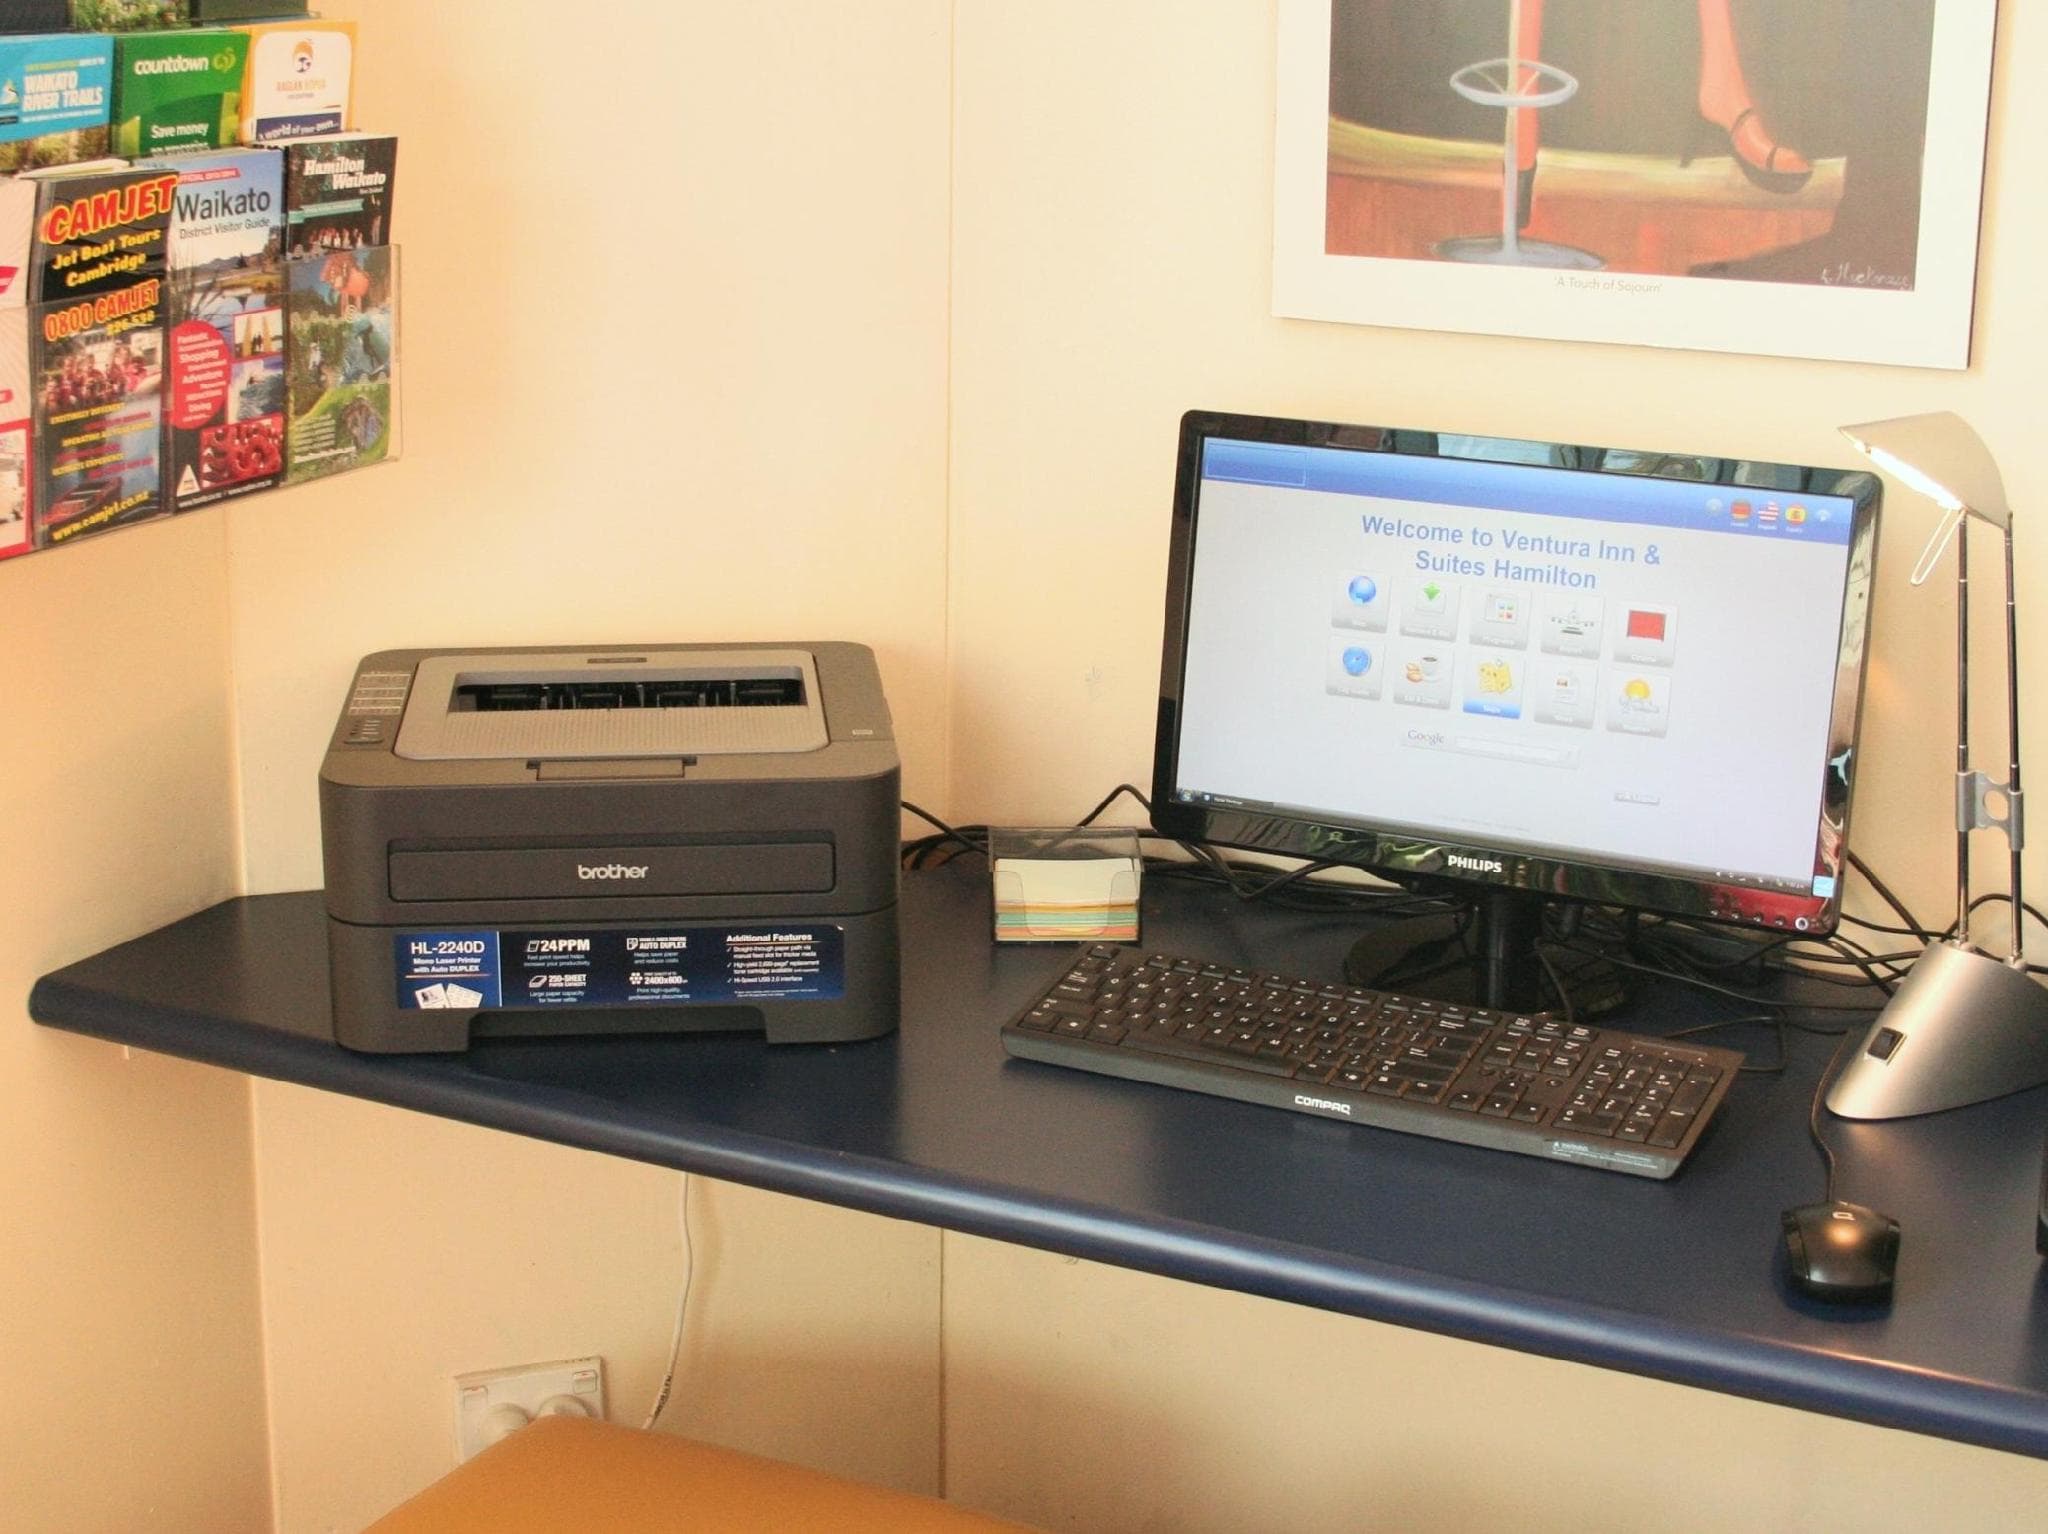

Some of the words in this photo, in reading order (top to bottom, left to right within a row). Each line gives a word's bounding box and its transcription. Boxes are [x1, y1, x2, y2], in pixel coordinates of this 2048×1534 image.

[134, 55, 209, 75] countdown
[24, 70, 78, 94] WAIKATO
[62, 86, 103, 107] TRAILS
[150, 124, 176, 139] Save
[176, 122, 209, 137] money
[264, 123, 292, 139] world
[303, 156, 365, 176] Hamilton
[332, 171, 387, 190] Waikato
[43, 174, 178, 244] CAMJET
[177, 187, 271, 223] Waikato
[180, 226, 213, 239] District
[214, 221, 243, 234] Visitor
[244, 217, 271, 230] Guide
[52, 250, 78, 270] Jet
[79, 240, 116, 262] Boat
[119, 229, 162, 249] Tours
[65, 252, 147, 287] Cambridge
[1568, 276, 1600, 290] Touch
[1602, 279, 1616, 291] of
[44, 303, 93, 342] 0800
[94, 279, 160, 323] CAMJET
[179, 349, 219, 364] Shopping
[52, 490, 150, 541] www.camjet.co.nz
[1361, 515, 1463, 543] Welcome
[1471, 527, 1493, 547] to
[1502, 530, 1590, 557] Ventura
[1599, 540, 1635, 562] Inn
[1643, 544, 1661, 565] &
[1415, 550, 1485, 576] Suites
[1494, 559, 1596, 589] Hamilton
[1407, 729, 1445, 746] Google
[577, 863, 650, 880] brother
[1447, 855, 1502, 873] PHILIPS
[540, 938, 591, 953] 24PPM
[639, 941, 659, 950] AUTO
[660, 940, 687, 949] DUPLEX
[726, 934, 771, 942] Additional
[772, 933, 813, 942] Features
[411, 940, 485, 955] HL-2240D
[413, 957, 435, 965] Mono
[435, 956, 457, 964] Laser
[457, 956, 482, 964] Printer
[413, 966, 430, 974] with
[430, 965, 449, 973] Auto
[449, 964, 480, 973] DUPLEX
[1294, 1094, 1352, 1116] COMPAQ
